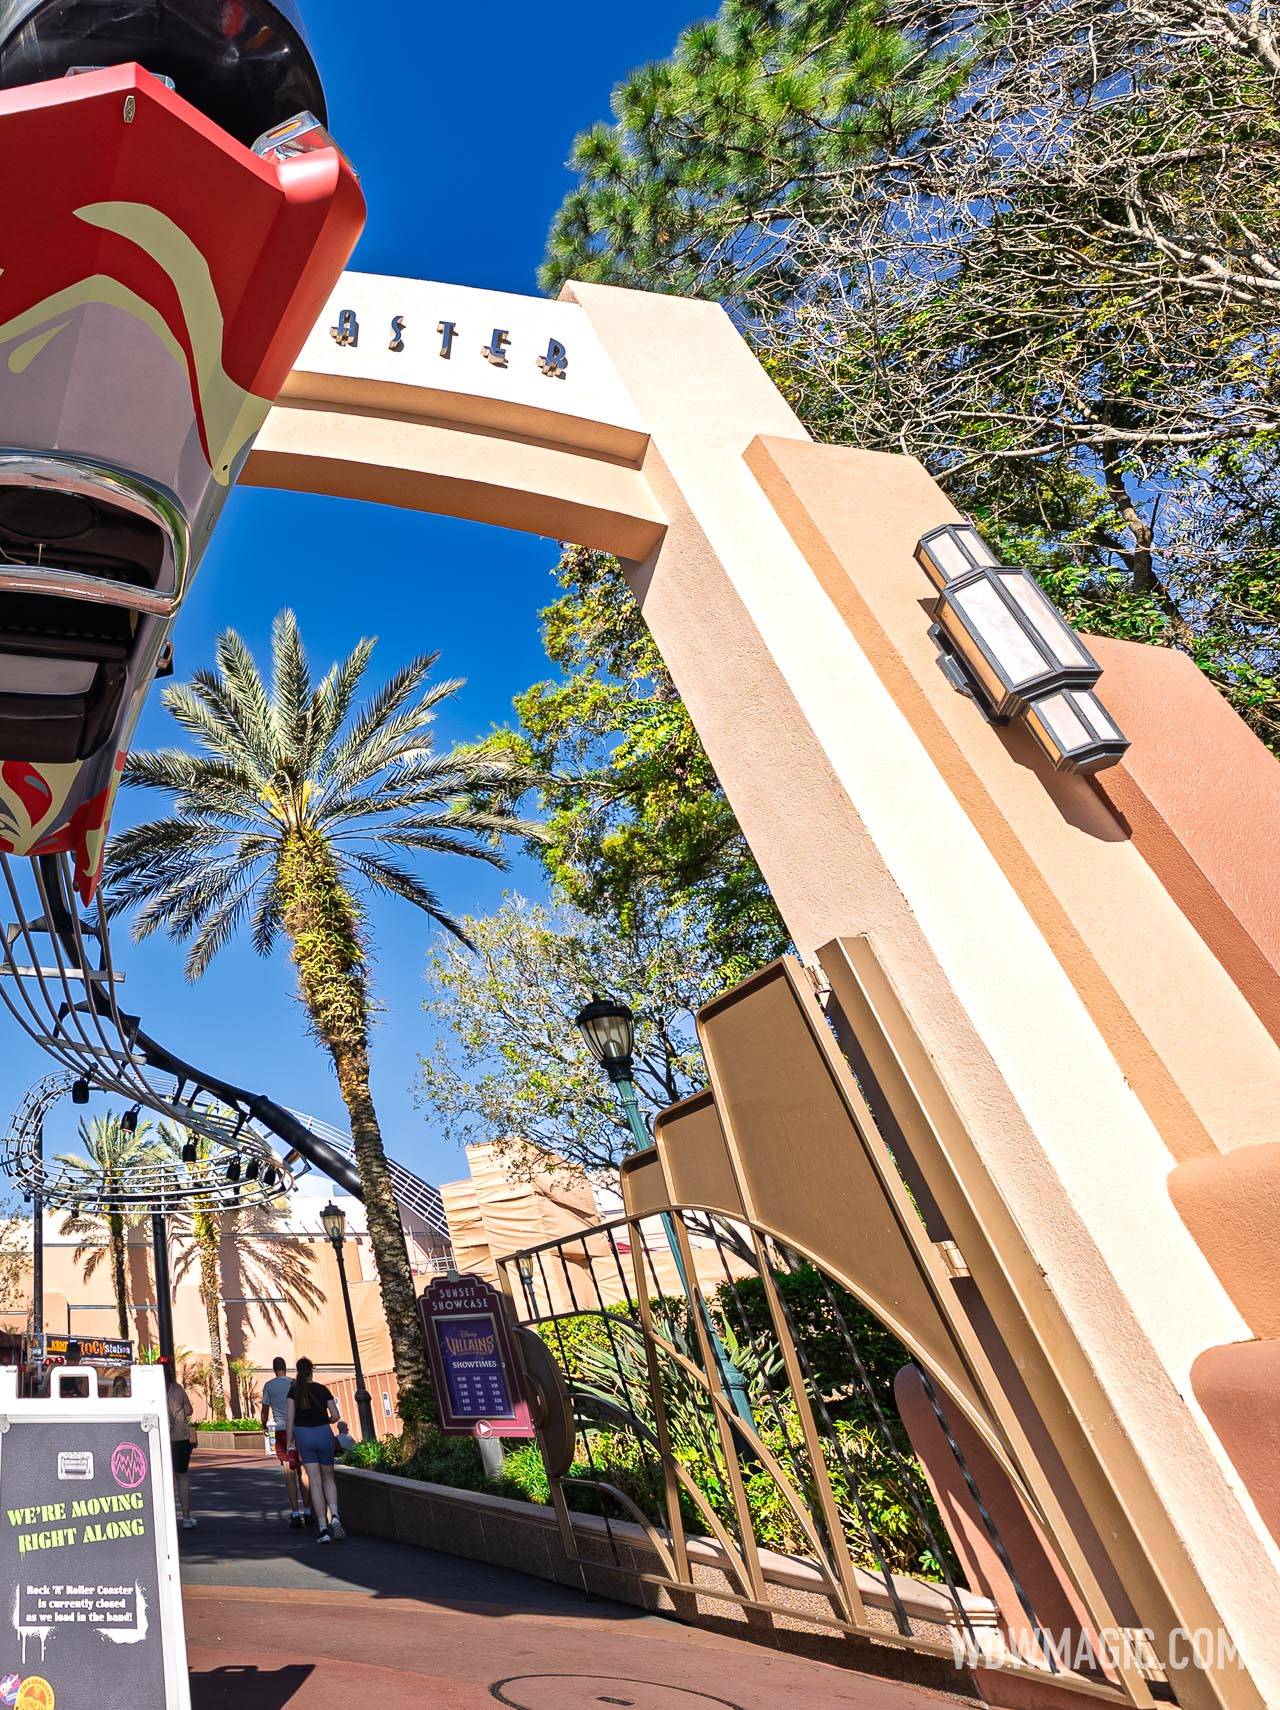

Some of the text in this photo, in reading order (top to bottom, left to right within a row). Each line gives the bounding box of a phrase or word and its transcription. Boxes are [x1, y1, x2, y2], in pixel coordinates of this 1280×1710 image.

[330, 309, 568, 380] ASTER
[439, 1287, 476, 1299] SUNSET
[432, 1298, 488, 1311] SHOWCASE
[445, 1335, 494, 1356] VILLAINS
[452, 1360, 497, 1369] SHOWTIMES
[7, 1492, 144, 1527] WE'RE MOVING
[18, 1518, 145, 1553] RIGHT ALONG
[26, 1585, 50, 1595] Rock
[65, 1585, 95, 1595] Roller
[96, 1585, 134, 1595] Coaster
[37, 1598, 126, 1611] is currently closed
[25, 1612, 133, 1622] as we load in the band!
